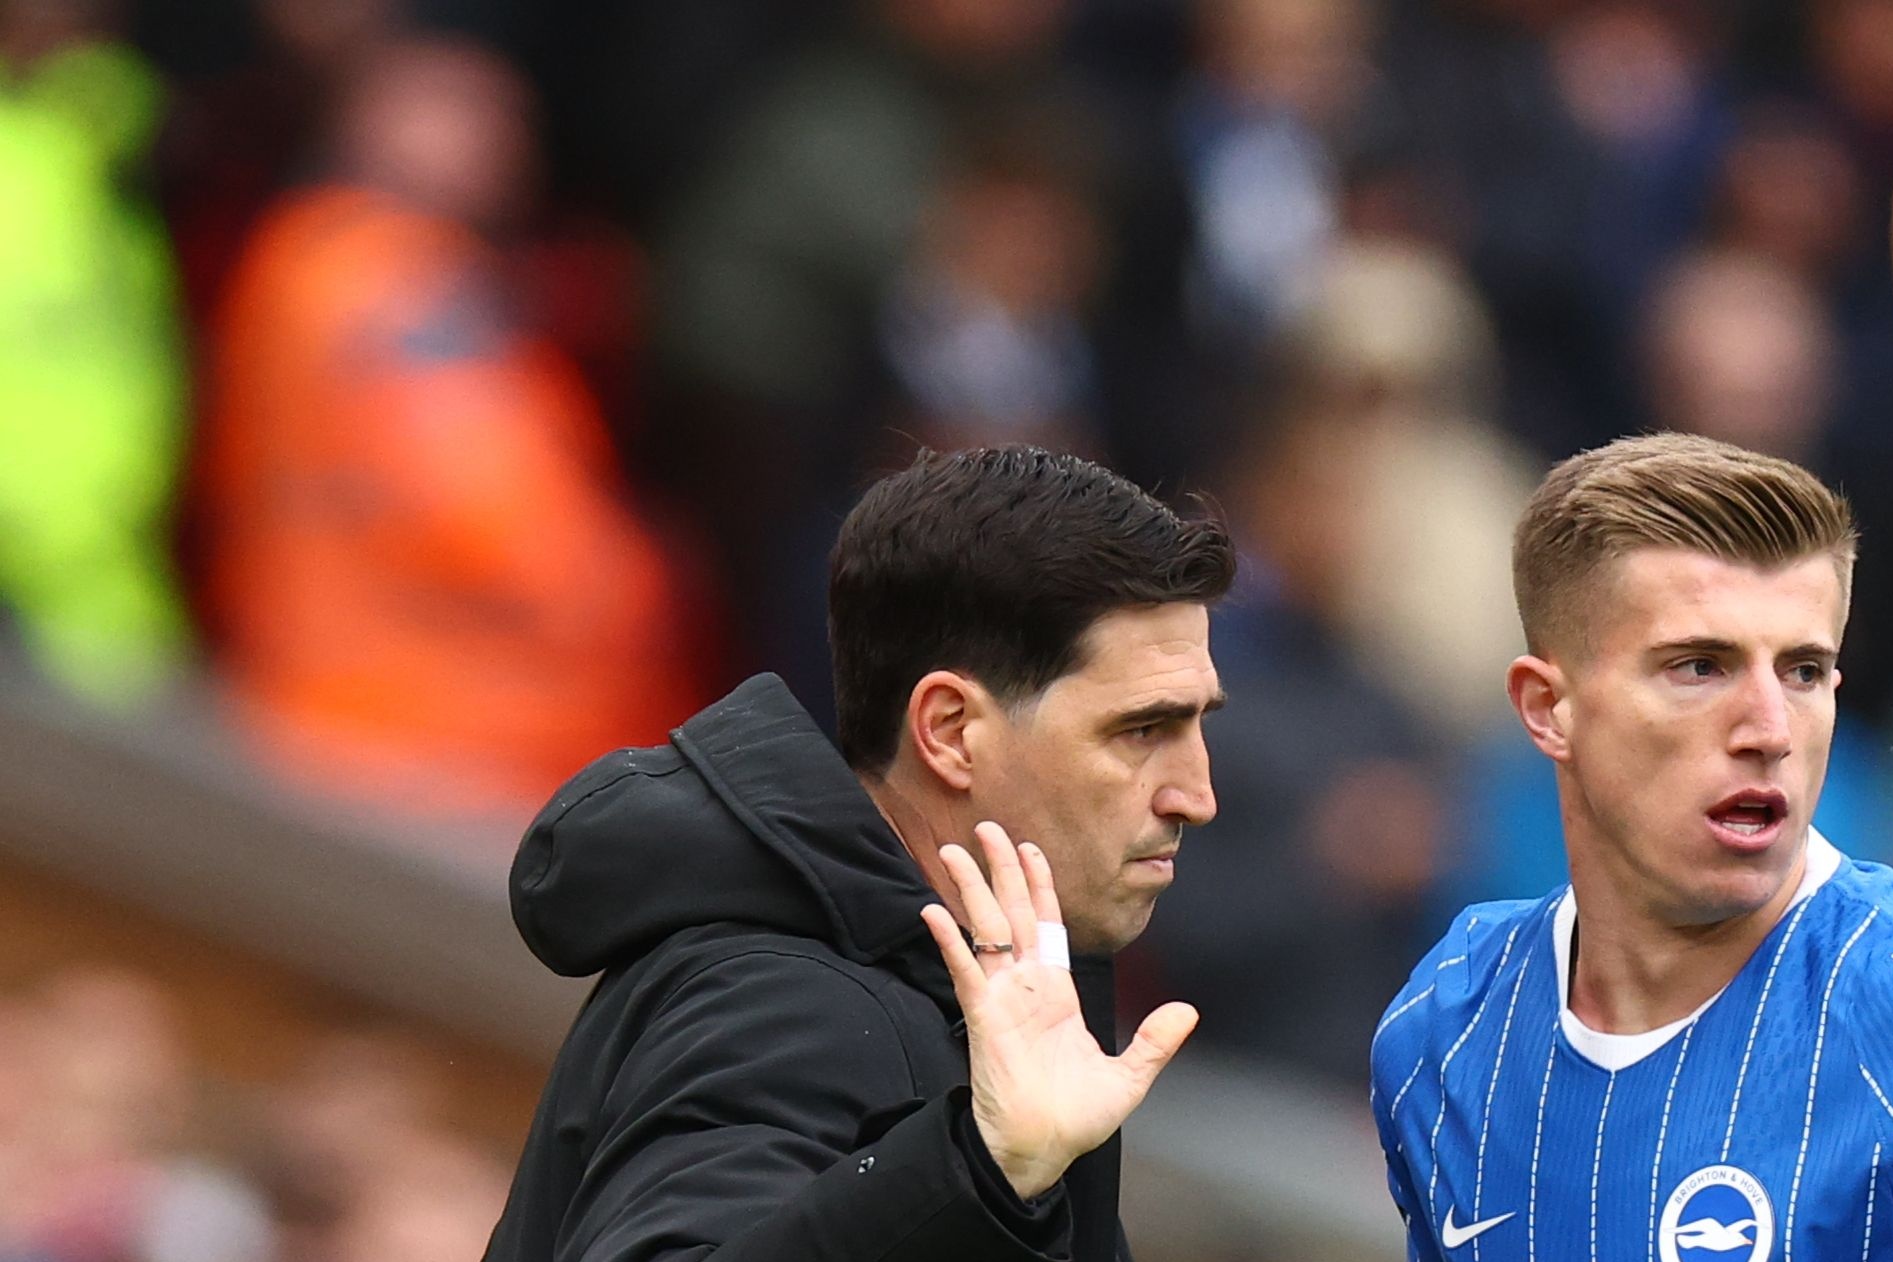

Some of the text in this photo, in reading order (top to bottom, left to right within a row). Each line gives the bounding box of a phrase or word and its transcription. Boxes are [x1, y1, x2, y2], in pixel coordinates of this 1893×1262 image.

[1674, 1171, 1764, 1206] BRIGHTON & HOVE
